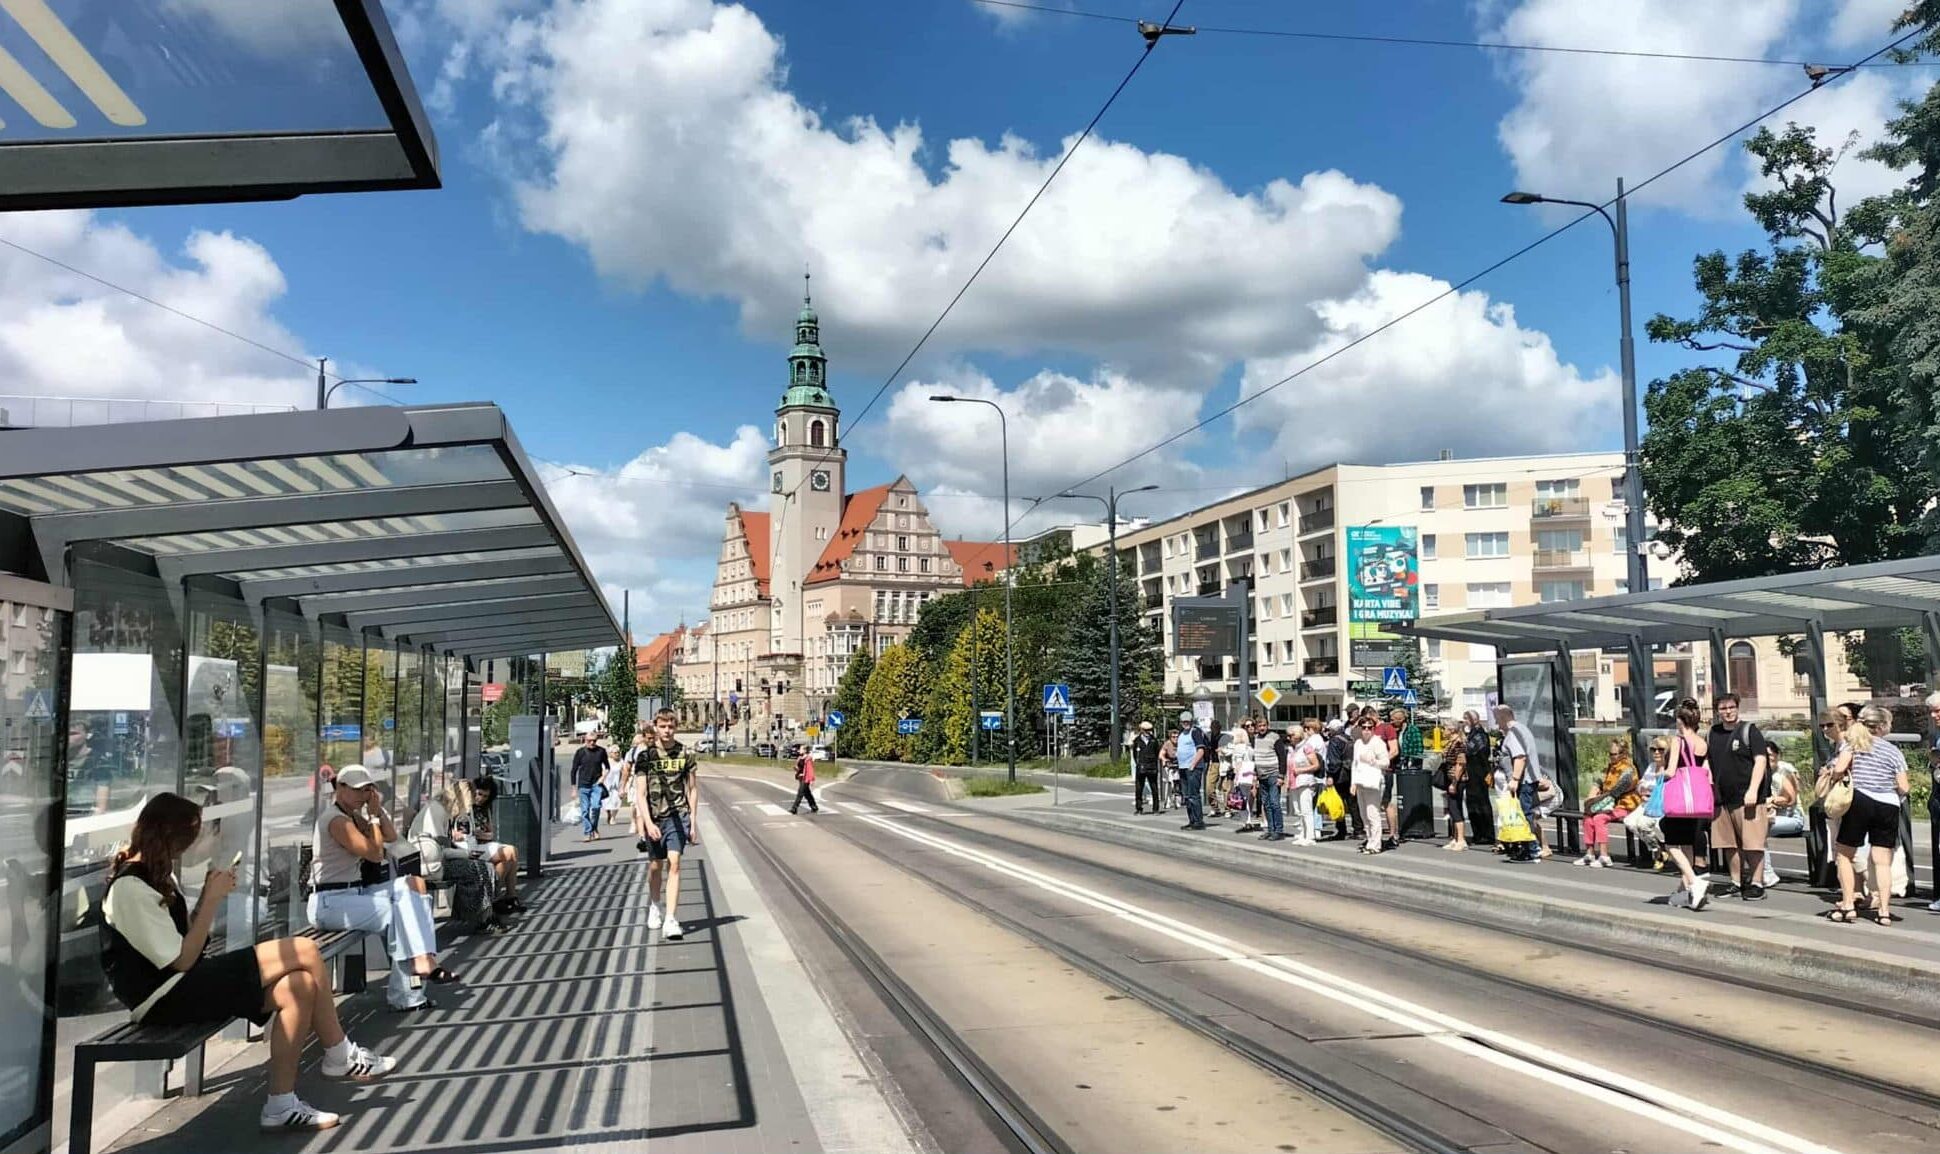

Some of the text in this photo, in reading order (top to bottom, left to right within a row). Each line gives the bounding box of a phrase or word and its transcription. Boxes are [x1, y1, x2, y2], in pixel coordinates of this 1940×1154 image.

[1353, 599, 1380, 608] KARTA
[1358, 609, 1376, 619] GRA
[1377, 609, 1414, 619] MUZYKA!
